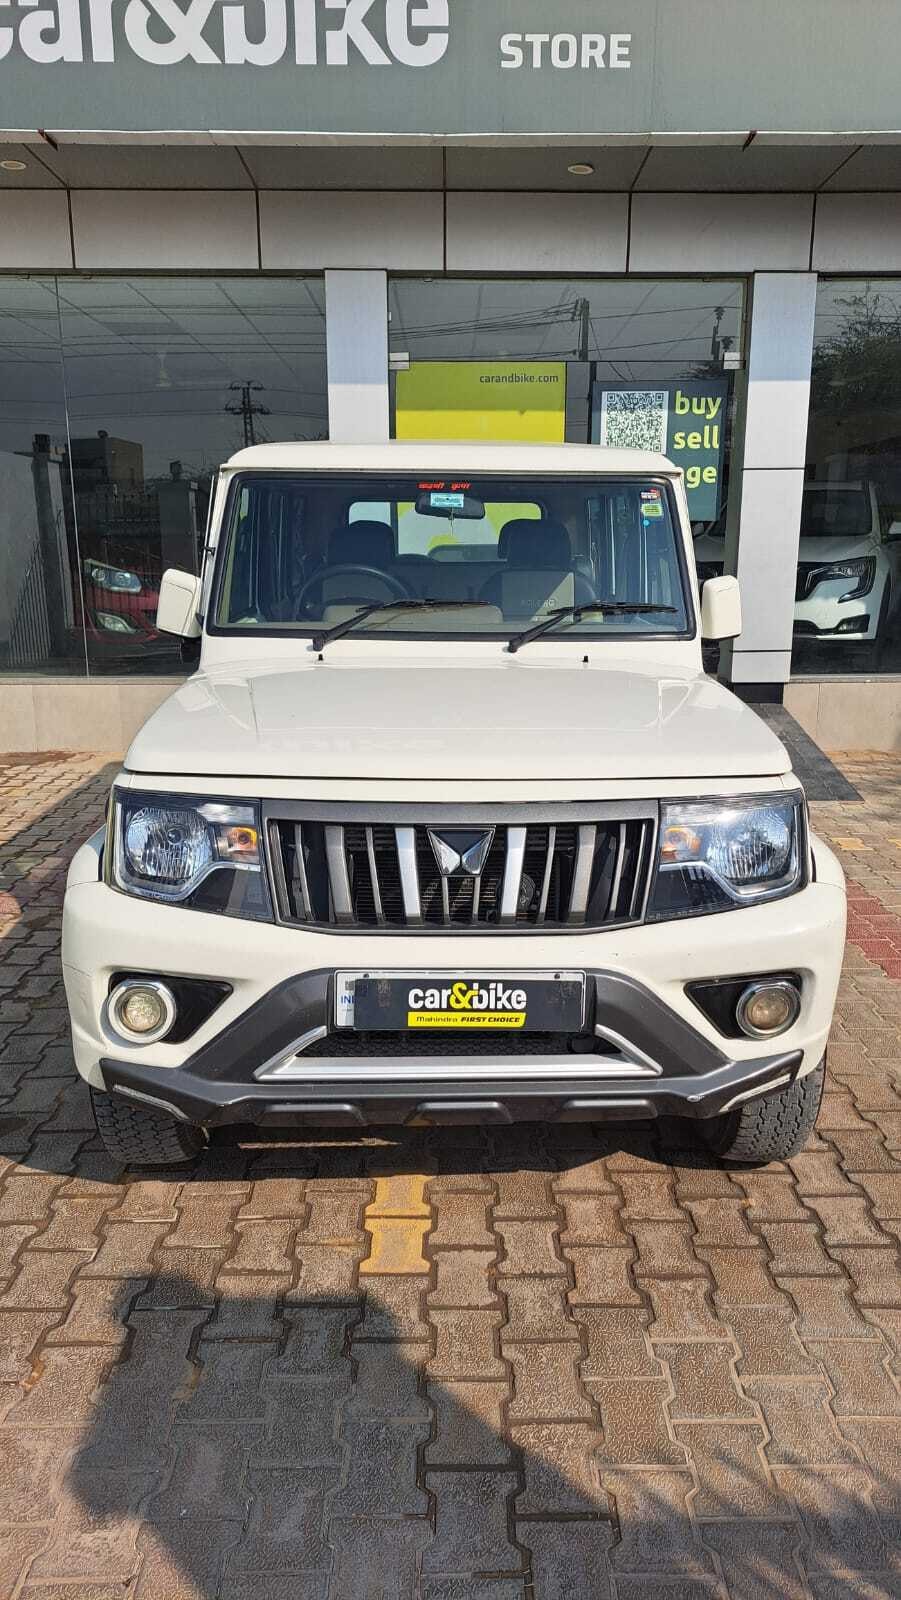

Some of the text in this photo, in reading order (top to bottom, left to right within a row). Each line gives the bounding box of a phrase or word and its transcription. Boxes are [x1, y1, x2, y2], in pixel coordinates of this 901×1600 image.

[500, 33, 632, 69] STORE
[479, 373, 559, 383] carandbike.com
[675, 390, 722, 420] buy
[673, 425, 720, 449] sell
[340, 994, 355, 1005] IN
[408, 982, 527, 1010] car&bike
